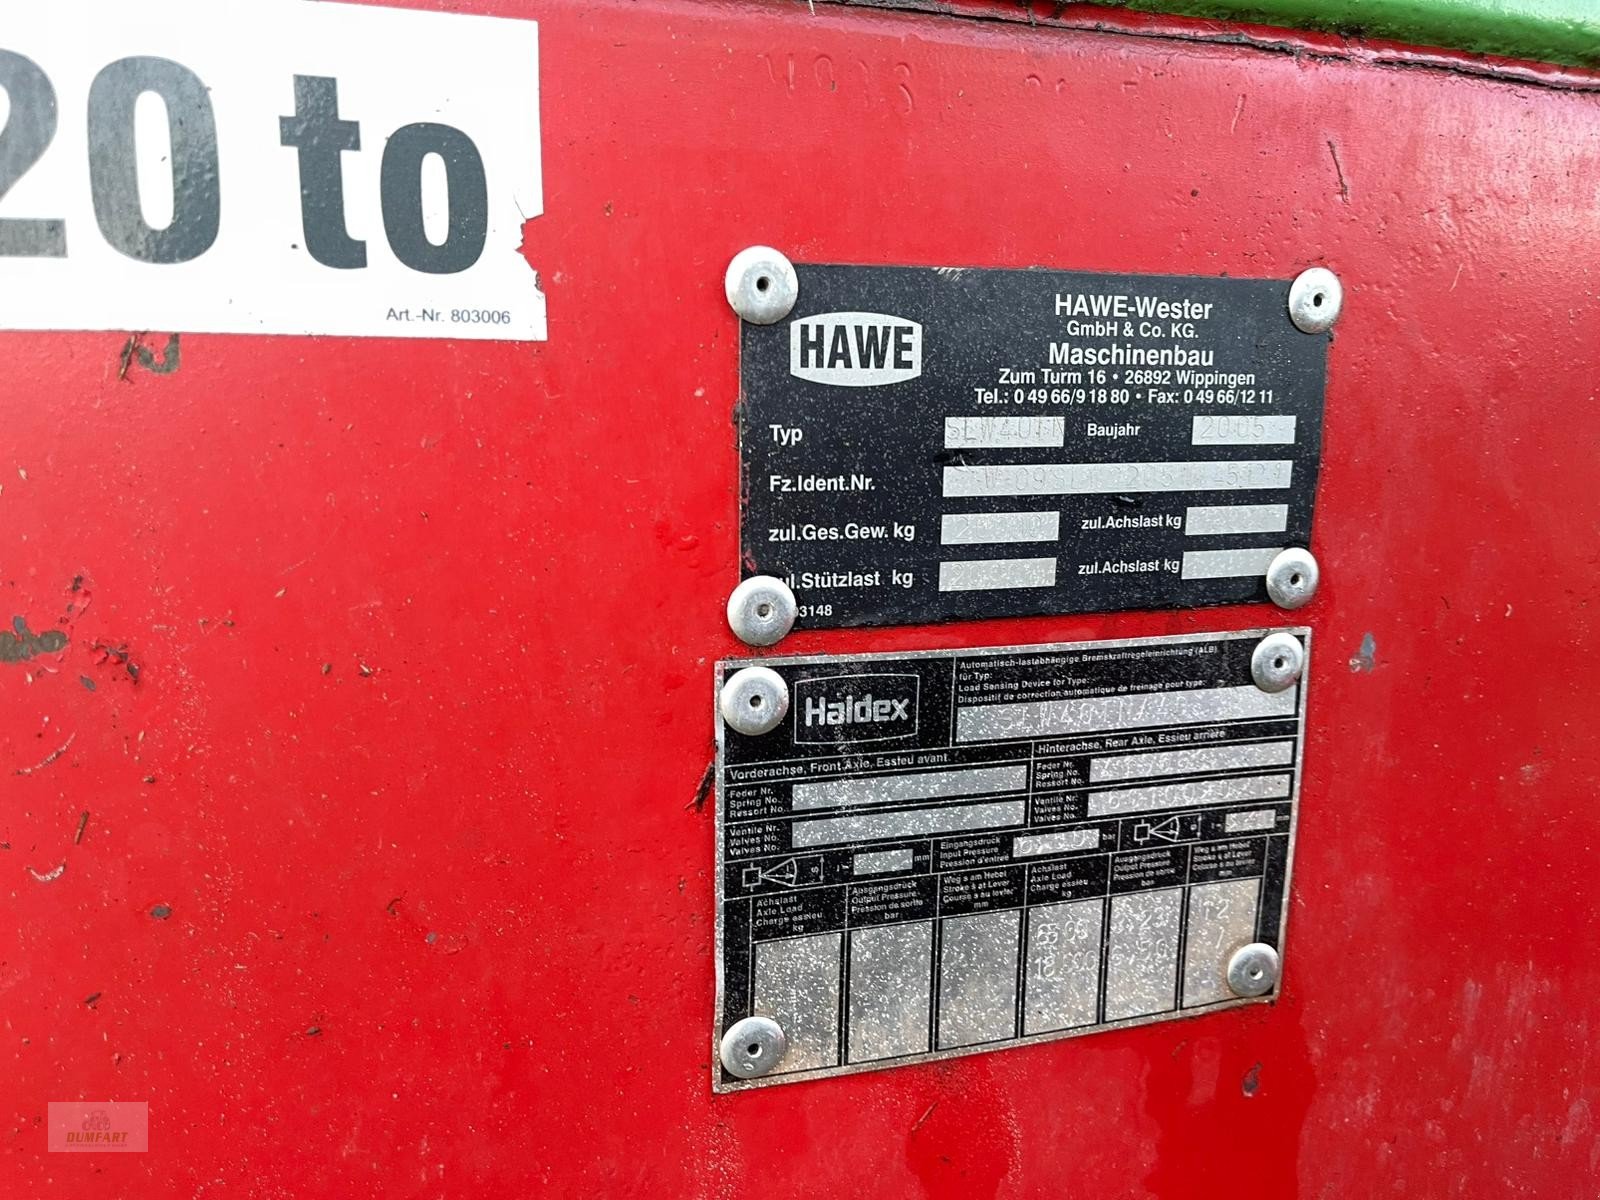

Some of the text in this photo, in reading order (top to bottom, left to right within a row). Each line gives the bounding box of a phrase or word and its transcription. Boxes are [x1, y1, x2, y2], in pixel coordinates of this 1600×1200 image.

[279, 74, 488, 274] to
[1055, 294, 1213, 319] HAWE-Wester
[386, 307, 511, 325] Art.-Nr. 803006
[1067, 321, 1199, 338] GmbH & Co. KG.
[800, 324, 913, 369] HAWE
[1049, 343, 1214, 366] Maschinenbau
[999, 369, 1255, 389] Zum Turm 16 26892 Wippingen
[974, 389, 1009, 404] Tel.:
[1148, 390, 1179, 404] Fax:
[769, 424, 803, 446] Typ
[1087, 423, 1140, 437] Baujahr
[769, 474, 876, 492] Fz.Ident.Nr.
[1081, 513, 1163, 529] zul.Achslast
[1165, 515, 1182, 531] kg
[768, 522, 915, 541] zul.Ges.Gew. kg
[1078, 560, 1160, 575] zul.Achslast
[1163, 559, 1180, 575] kg
[780, 569, 913, 590] ul.Stützlast kg
[959, 683, 979, 692] Load
[981, 681, 1018, 692] Sensing
[1022, 679, 1050, 689] Device
[1052, 677, 1066, 688] for
[958, 691, 1001, 704] Dispositif
[1003, 692, 1014, 701] de
[1017, 689, 1062, 700] correction
[1064, 685, 1115, 699] automatique
[1117, 685, 1128, 694] de
[805, 694, 909, 726] Haldex
[1038, 740, 1103, 754] Hinterachse,
[1104, 737, 1128, 749] Rear
[1131, 733, 1156, 746] Axle,
[1158, 730, 1191, 743] Essieu
[730, 752, 949, 780] Vorderachse, Front Axle, Essieu avant
[1036, 770, 1064, 780] Spring
[730, 786, 774, 799] Feder Nr.
[730, 796, 780, 810] Spring No.
[730, 807, 768, 818] Ressort
[730, 826, 763, 837] Ventile
[730, 834, 779, 847] Valves No.
[730, 843, 780, 856] Valves No.
[940, 846, 999, 860] Input Pressure
[939, 857, 975, 869] Pression
[1031, 871, 1073, 883] Axle Load
[1030, 882, 1060, 893] Charge
[757, 895, 798, 908] Achslast
[973, 901, 989, 909] mm
[757, 904, 803, 917] Axle Load
[852, 904, 887, 915] Pression
[884, 912, 900, 920] bar
[756, 916, 790, 927] Charge
